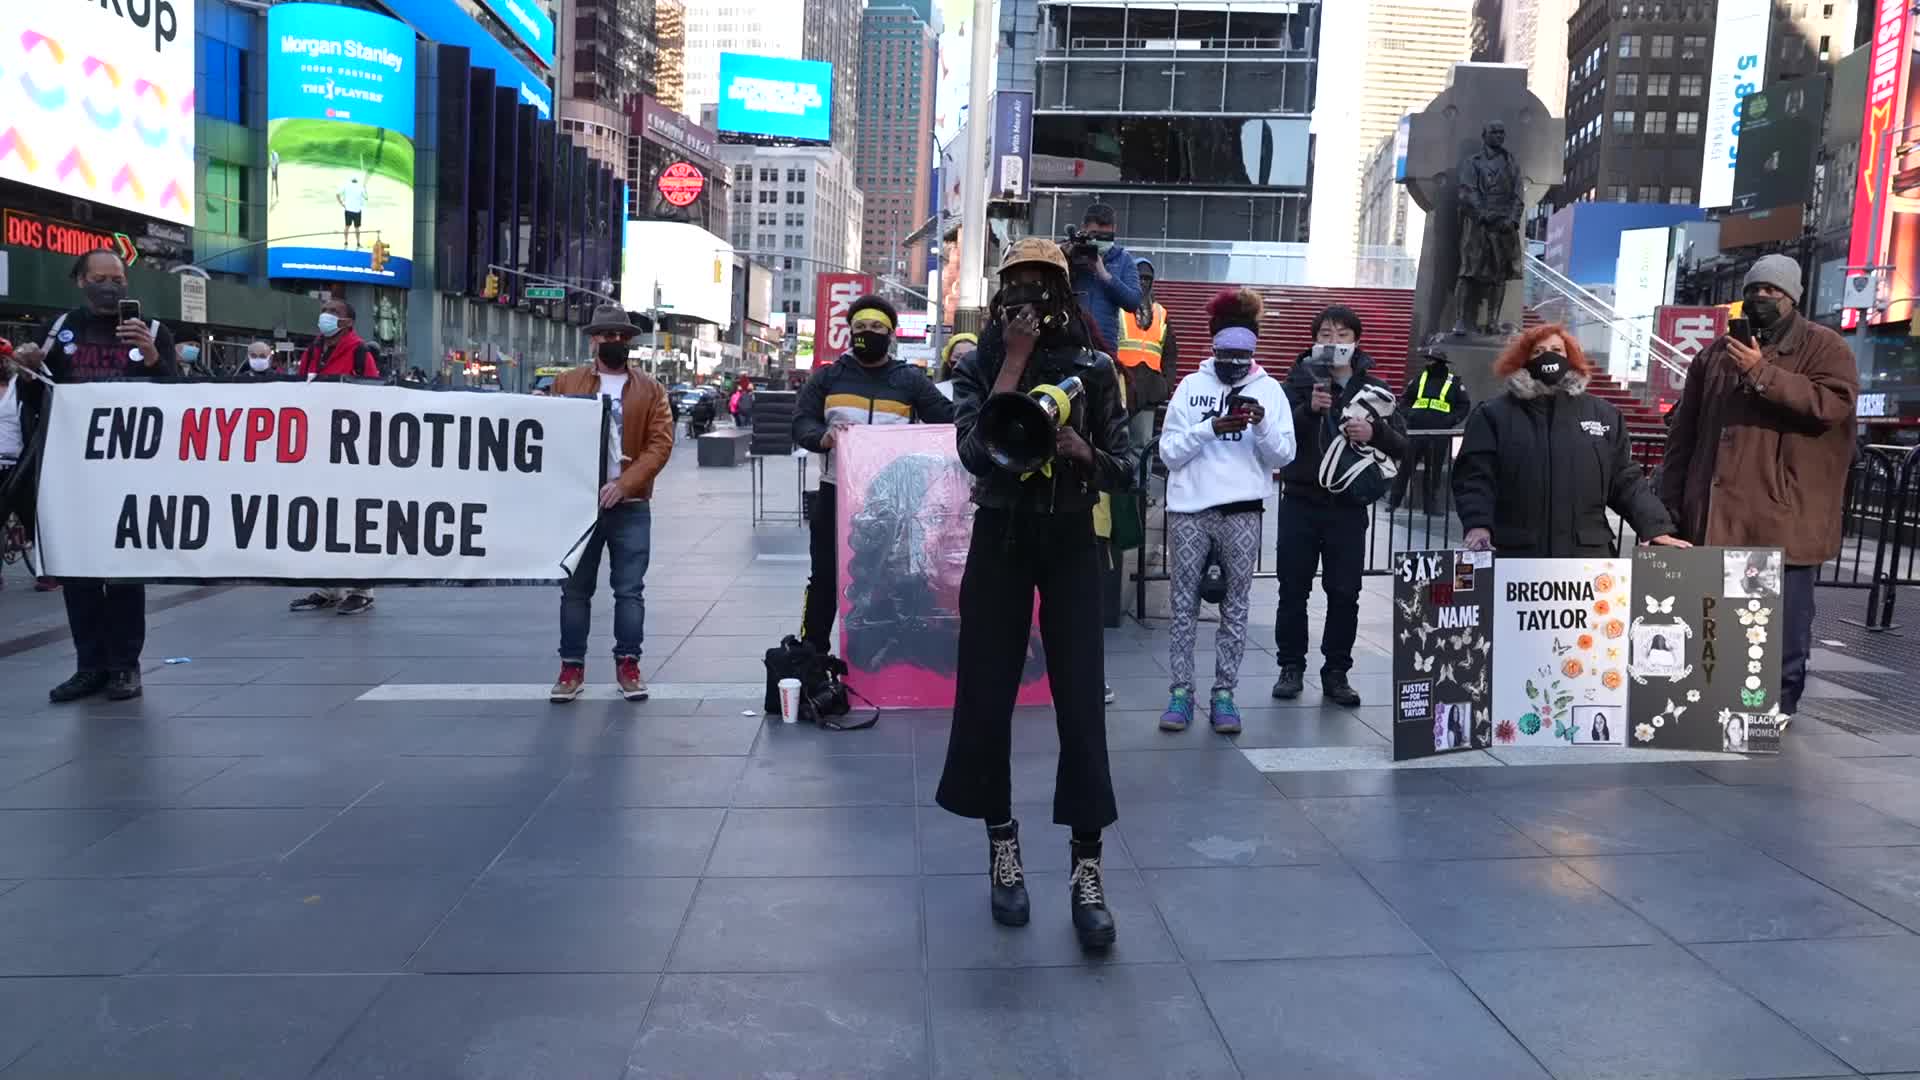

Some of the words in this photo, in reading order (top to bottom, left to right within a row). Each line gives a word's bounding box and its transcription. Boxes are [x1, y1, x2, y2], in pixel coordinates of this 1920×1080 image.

[281, 35, 342, 58] Morgan
[343, 39, 403, 73] Stanley
[8, 215, 42, 249] DOS
[85, 406, 164, 461] END
[179, 406, 308, 464] NYPD
[330, 408, 544, 473] RIOTING
[115, 494, 210, 550] AND
[231, 493, 488, 557] VIOLENCE
[1403, 557, 1437, 582] SAY
[1506, 580, 1595, 602] BREONNA
[1438, 605, 1479, 628] NAME
[1517, 609, 1587, 631] TAYLOR
[1702, 597, 1716, 684] PRAY
[1401, 683, 1429, 694] JUSTICE
[1404, 708, 1426, 717] TAYLOR
[1748, 715, 1776, 724] BLACK
[1748, 729, 1780, 737] WOMEN
